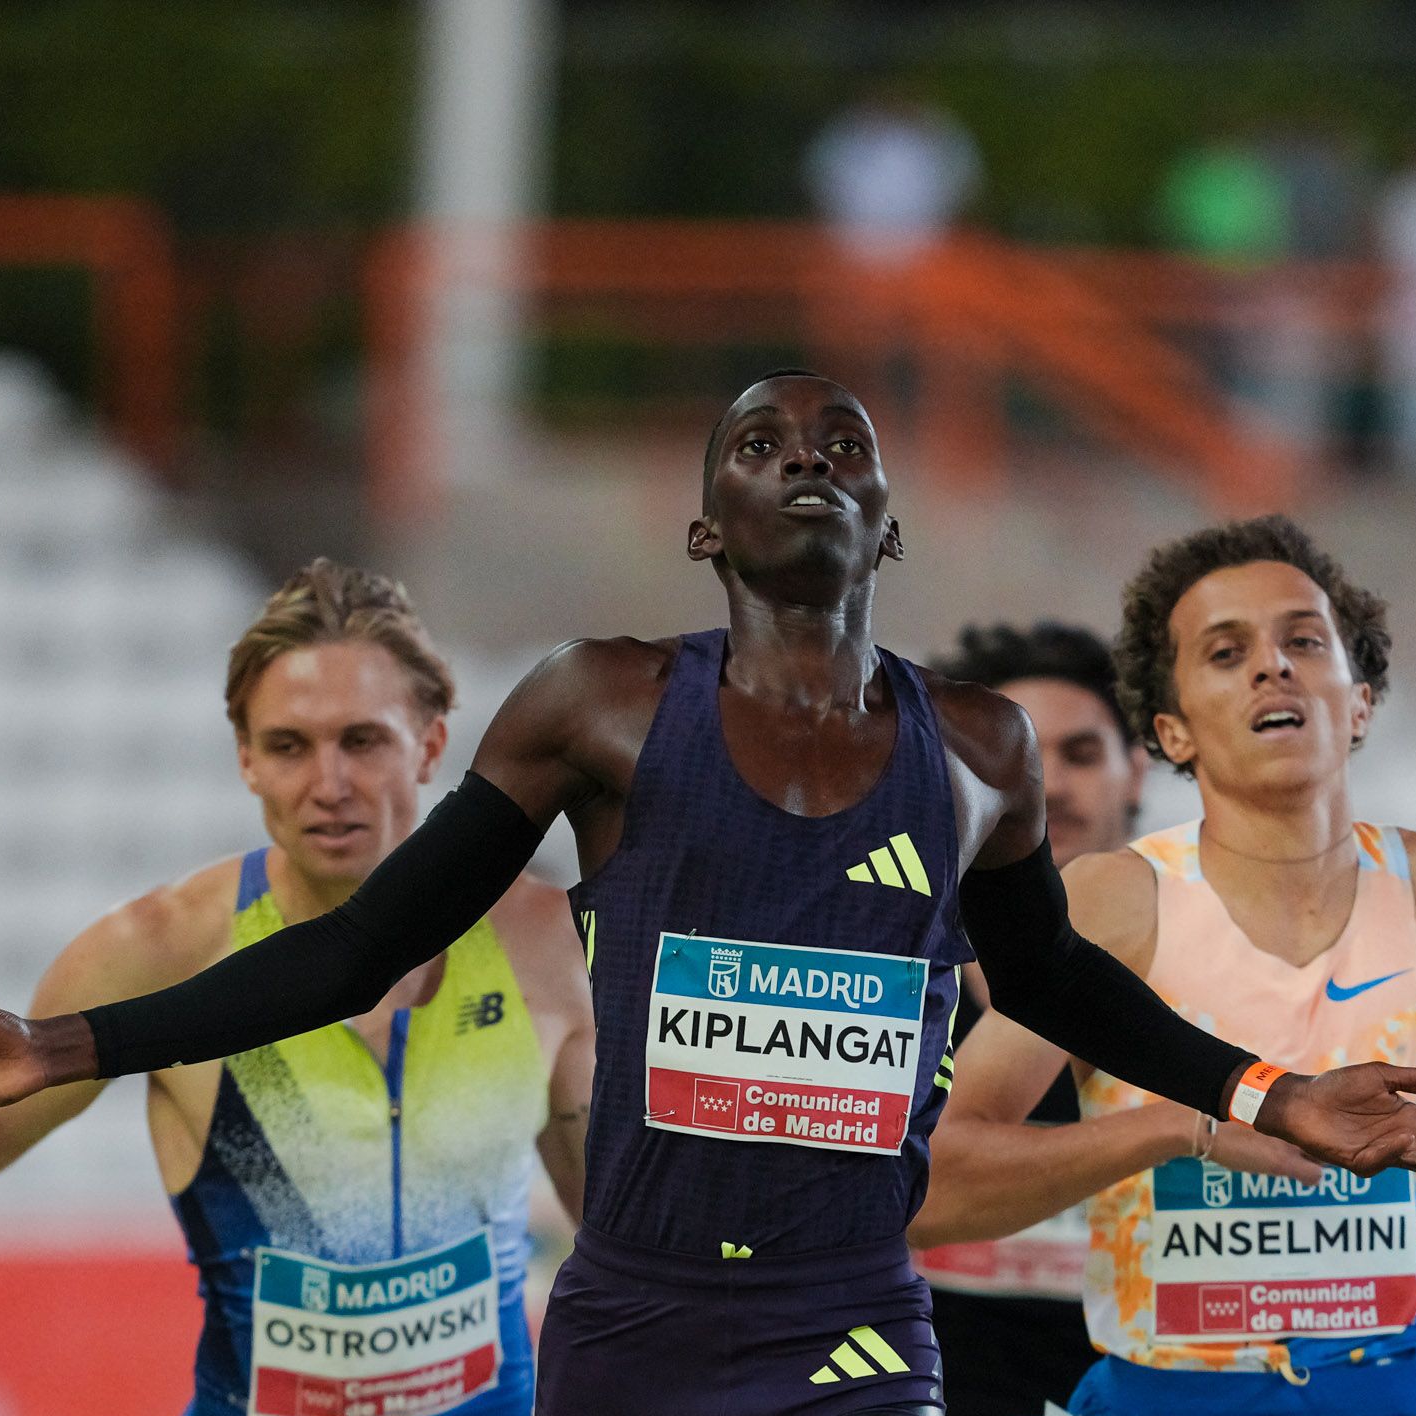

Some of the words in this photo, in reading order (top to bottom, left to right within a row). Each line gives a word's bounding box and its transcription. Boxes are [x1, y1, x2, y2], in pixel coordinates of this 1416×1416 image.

[749, 964, 883, 1008] MADRID
[659, 1006, 914, 1068] KIPLANGAT
[745, 1085, 880, 1116] Comunidad
[743, 1112, 776, 1133] de
[785, 1115, 878, 1144] Madrid
[1162, 1216, 1407, 1258] ANSELMINI
[336, 1262, 457, 1310] MADRID
[1250, 1281, 1376, 1305] Comunidad
[266, 1296, 487, 1358] OSTROWSKI
[1250, 1310, 1283, 1332] de
[1291, 1307, 1378, 1331] Madrid
